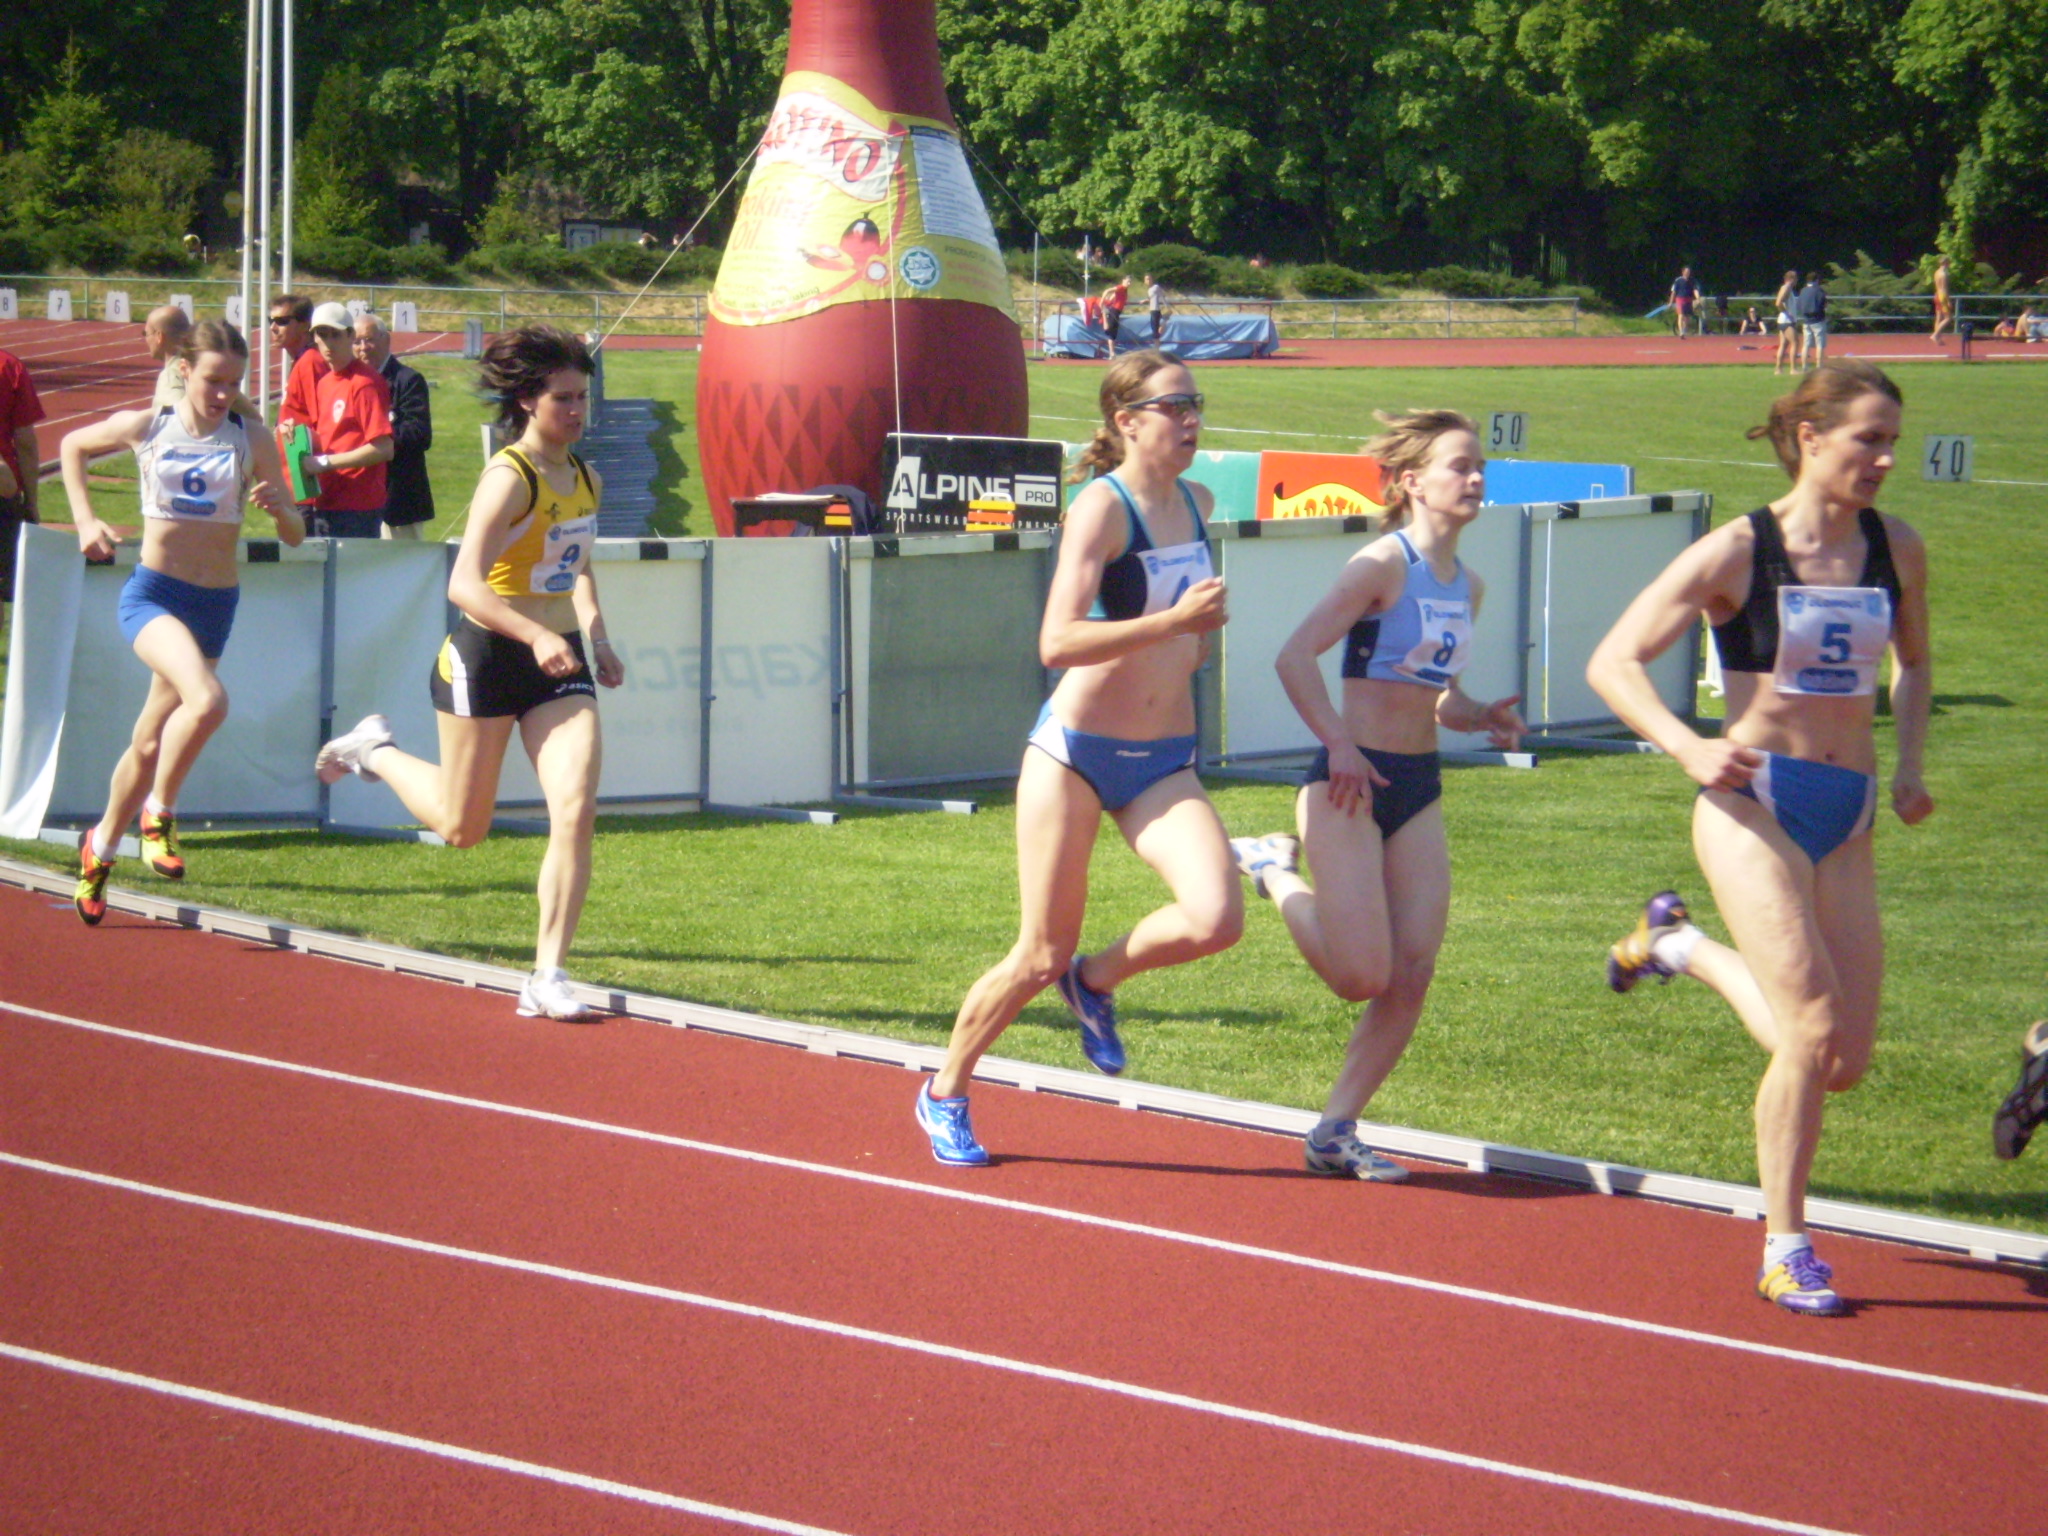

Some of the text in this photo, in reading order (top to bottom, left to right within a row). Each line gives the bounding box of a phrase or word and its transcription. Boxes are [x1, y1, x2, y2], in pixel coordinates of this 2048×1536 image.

[2, 297, 9, 312] 8
[57, 297, 64, 312] 7
[114, 299, 121, 314] 6
[401, 310, 408, 325] 1
[1492, 414, 1522, 445] 50
[1930, 440, 1965, 476] 40
[182, 467, 207, 497] 6
[887, 456, 1054, 508] ALPINE PRO
[557, 543, 581, 570] 9
[1433, 631, 1457, 668] 8
[1819, 622, 1852, 664] 5
